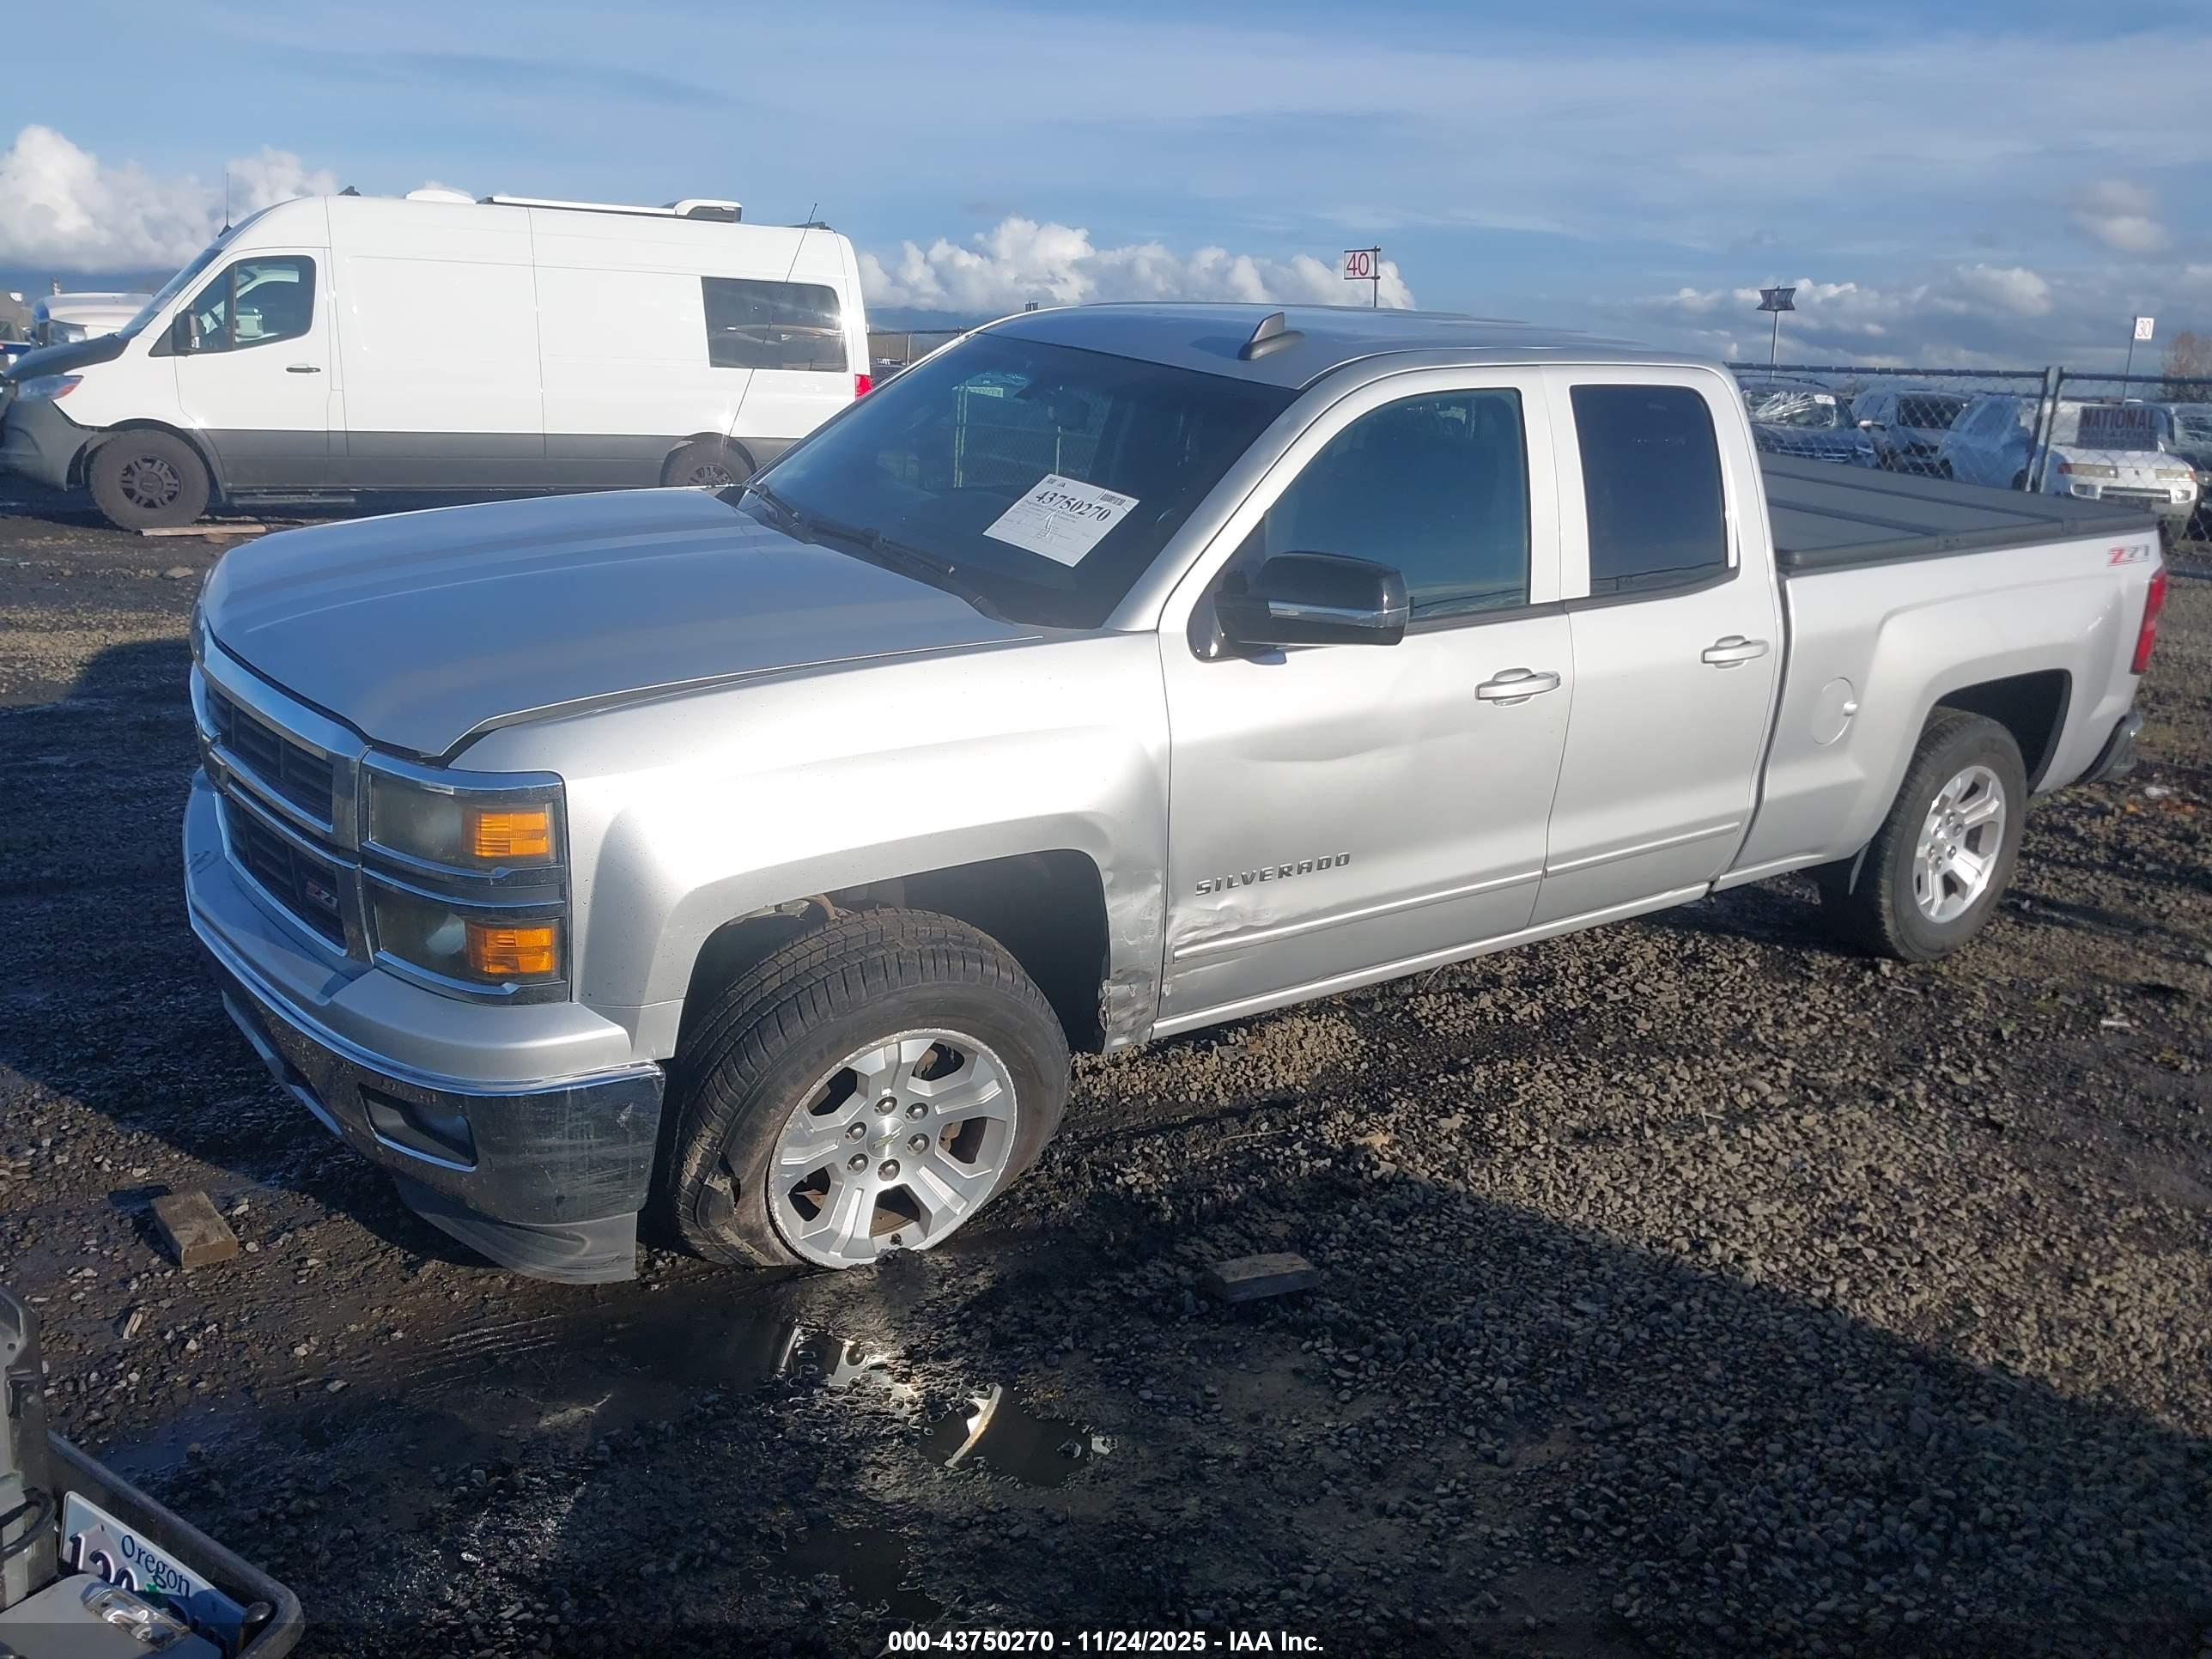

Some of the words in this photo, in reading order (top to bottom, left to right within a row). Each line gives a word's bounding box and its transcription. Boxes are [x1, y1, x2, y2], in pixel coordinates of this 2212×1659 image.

[1346, 252, 1370, 276] 40
[2136, 319, 2151, 337] 30
[2081, 408, 2156, 430] NATIONAL
[1035, 489, 1113, 523] 43750270
[2108, 545, 2151, 567] Z71
[1194, 851, 1352, 896] SILVERADO
[121, 1534, 191, 1601] Oregon
